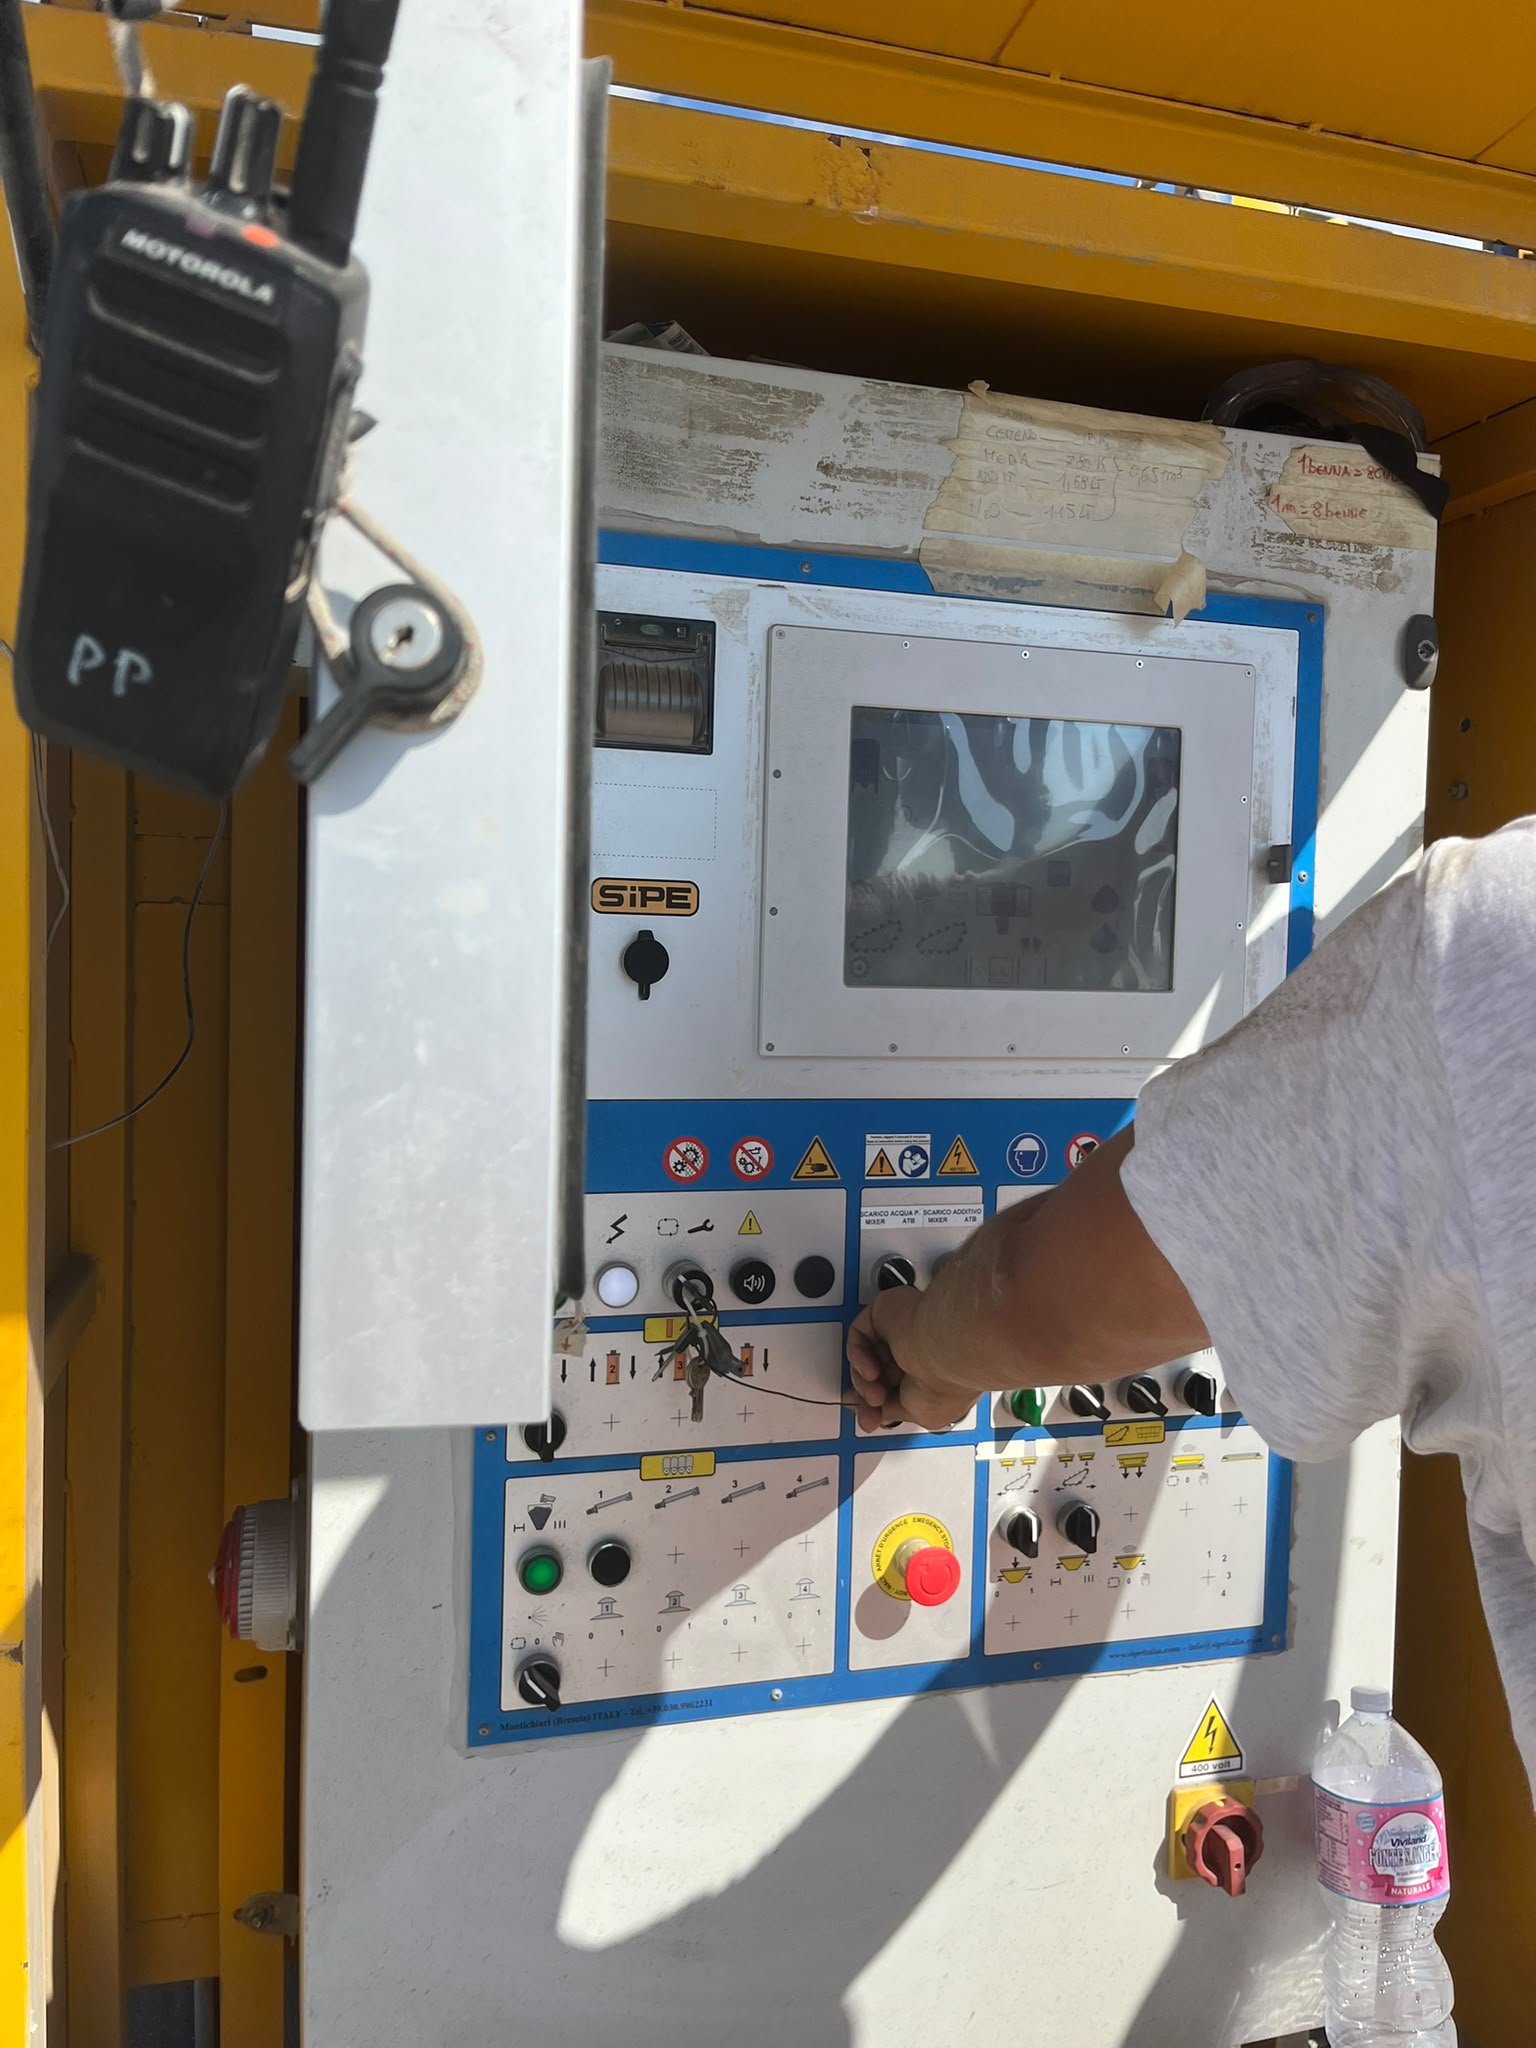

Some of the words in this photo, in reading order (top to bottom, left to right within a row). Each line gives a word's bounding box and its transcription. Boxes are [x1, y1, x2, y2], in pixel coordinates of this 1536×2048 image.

[121, 228, 274, 306] MOTOROLA
[953, 1207, 982, 1215] ADDITIVO
[609, 1364, 616, 1374] 2
[677, 1361, 684, 1370] 3
[592, 1711, 621, 1722] ITALY
[1192, 1763, 1209, 1773] 400
[1212, 1760, 1231, 1770] volt
[1391, 1882, 1431, 1897] NATURALE
